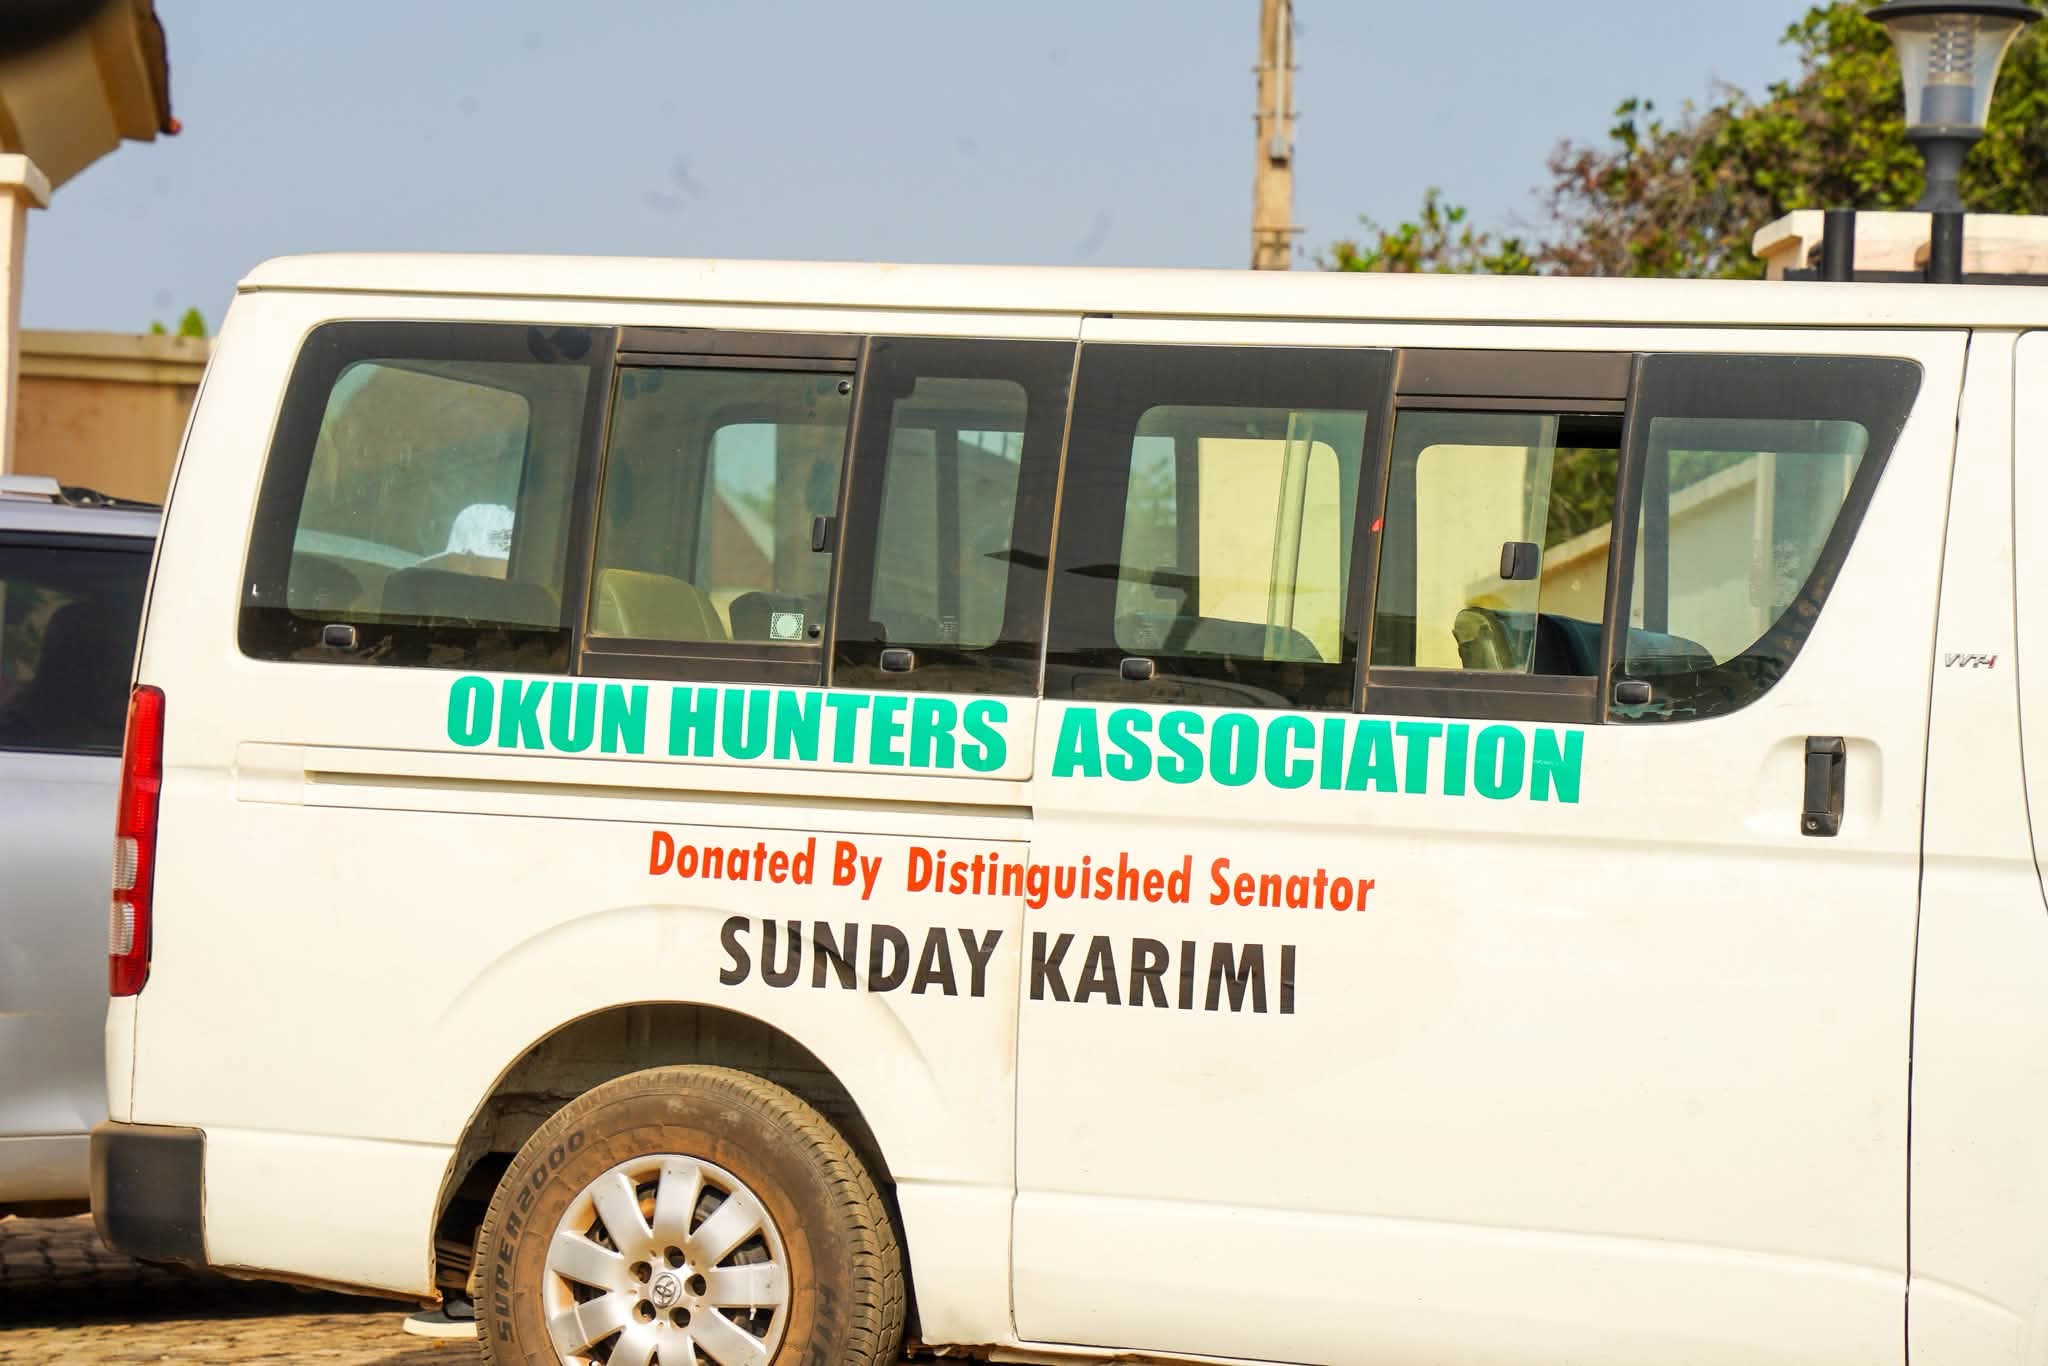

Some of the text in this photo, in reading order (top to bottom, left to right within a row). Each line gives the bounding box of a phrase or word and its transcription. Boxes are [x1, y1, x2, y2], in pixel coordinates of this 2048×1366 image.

[446, 675, 1585, 804] OKUN HUNTERS ASSOCIATION
[649, 830, 1375, 912] Donated By Distinguished Senator
[719, 916, 1296, 1015] SUNDAY KARIMI
